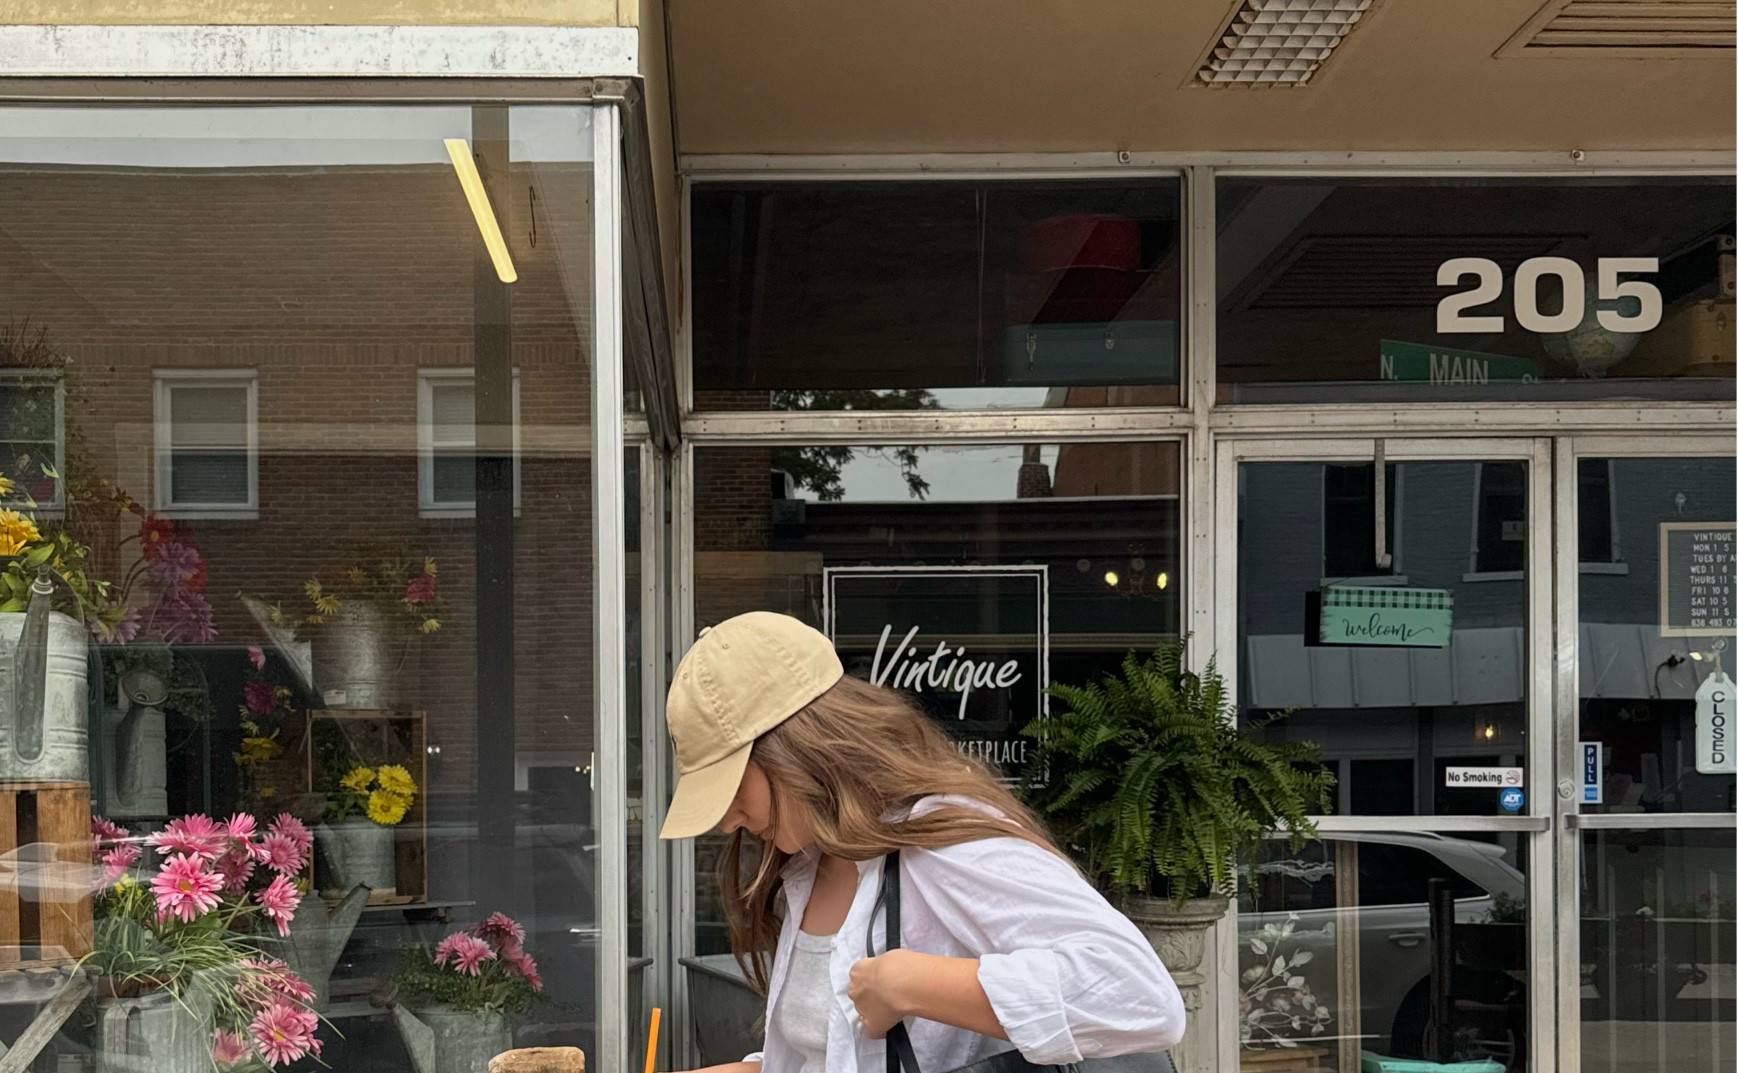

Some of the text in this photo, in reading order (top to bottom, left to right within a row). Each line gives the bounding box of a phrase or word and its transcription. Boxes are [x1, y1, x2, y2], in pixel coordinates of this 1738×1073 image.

[1437, 257, 1663, 333] 205
[1380, 354, 1398, 380] N.
[1429, 353, 1489, 385] MAIN
[1693, 533, 1732, 541] VINTIQUE
[1693, 544, 1710, 552] MON
[1693, 555, 1713, 563] TUES
[1717, 555, 1726, 563] BY
[1690, 576, 1716, 584] THURS
[1692, 587, 1706, 595] FRI
[1691, 608, 1707, 616] SUN
[1342, 612, 1434, 642] welcome
[870, 624, 1022, 720] Vintique
[1711, 691, 1725, 764] CLOSED
[1448, 772, 1502, 785] No Smoking
[1504, 794, 1521, 803] ADT
